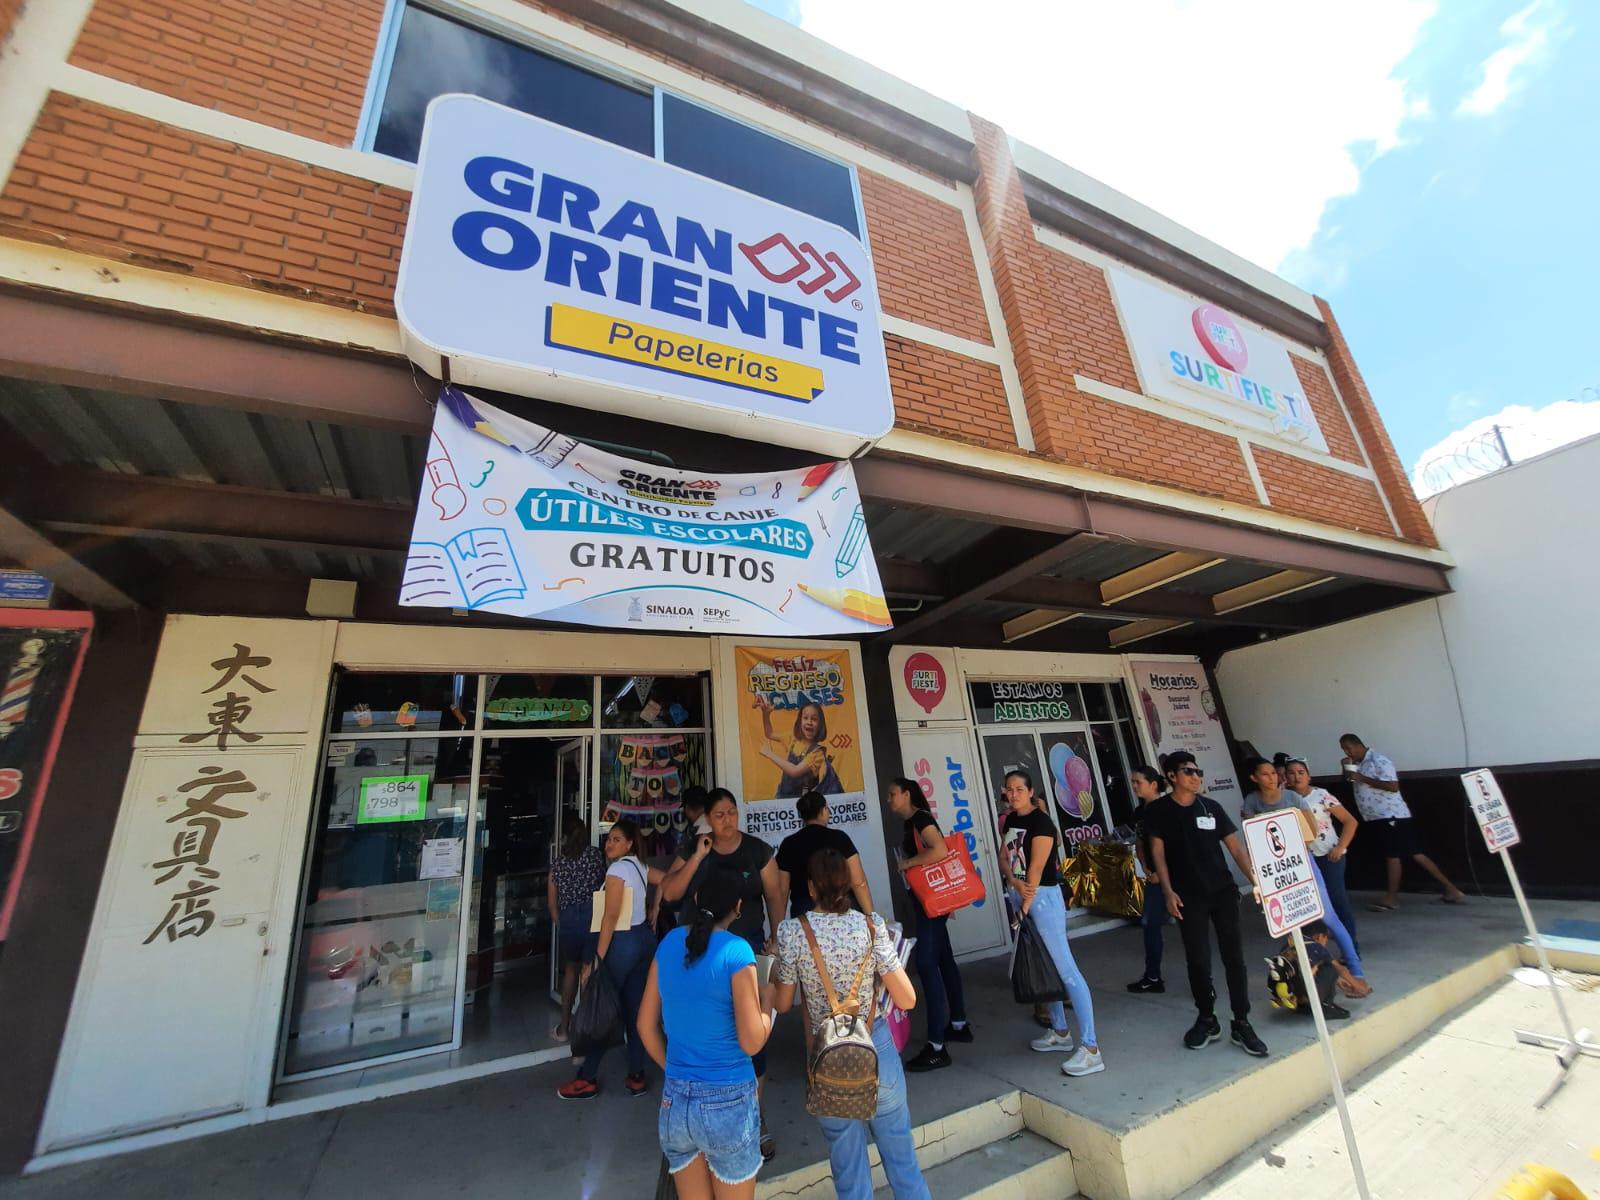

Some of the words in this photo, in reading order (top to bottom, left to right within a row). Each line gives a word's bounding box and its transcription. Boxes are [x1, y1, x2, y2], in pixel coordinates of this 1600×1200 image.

[464, 156, 733, 276] GRAN
[452, 211, 861, 366] ORIENTE
[608, 322, 779, 384] Papelerías
[1170, 350, 1312, 424] SURTIFIEST
[619, 469, 686, 488] GRAN
[617, 479, 717, 501] ORIENTE
[568, 481, 672, 517] CENTRO
[678, 510, 702, 520] DE
[705, 508, 779, 521] CANJE
[530, 491, 645, 530] ÚTILES
[652, 522, 807, 551] ESCOLARES
[570, 541, 776, 584] GRATUITOS
[646, 604, 694, 616] SINALOA
[703, 608, 731, 618] SEPyC
[749, 670, 841, 693] REGRESO
[912, 671, 937, 680] SURTI
[1150, 673, 1199, 689] Horarios
[769, 688, 845, 710] CLASES
[991, 681, 1063, 698] ESTAMOS
[994, 701, 1072, 721] ABIERTOS
[631, 776, 662, 791] TO
[747, 810, 795, 823] PRECIOS
[747, 824, 760, 833] EN
[763, 821, 781, 832] TUS
[1065, 824, 1102, 845] TODO
[1261, 863, 1274, 878] SE
[1274, 853, 1304, 873] USARA
[1274, 871, 1299, 889] GRUA
[1282, 886, 1310, 903] EXCLUSIVO
[1285, 903, 1318, 923] COMPRANDO
